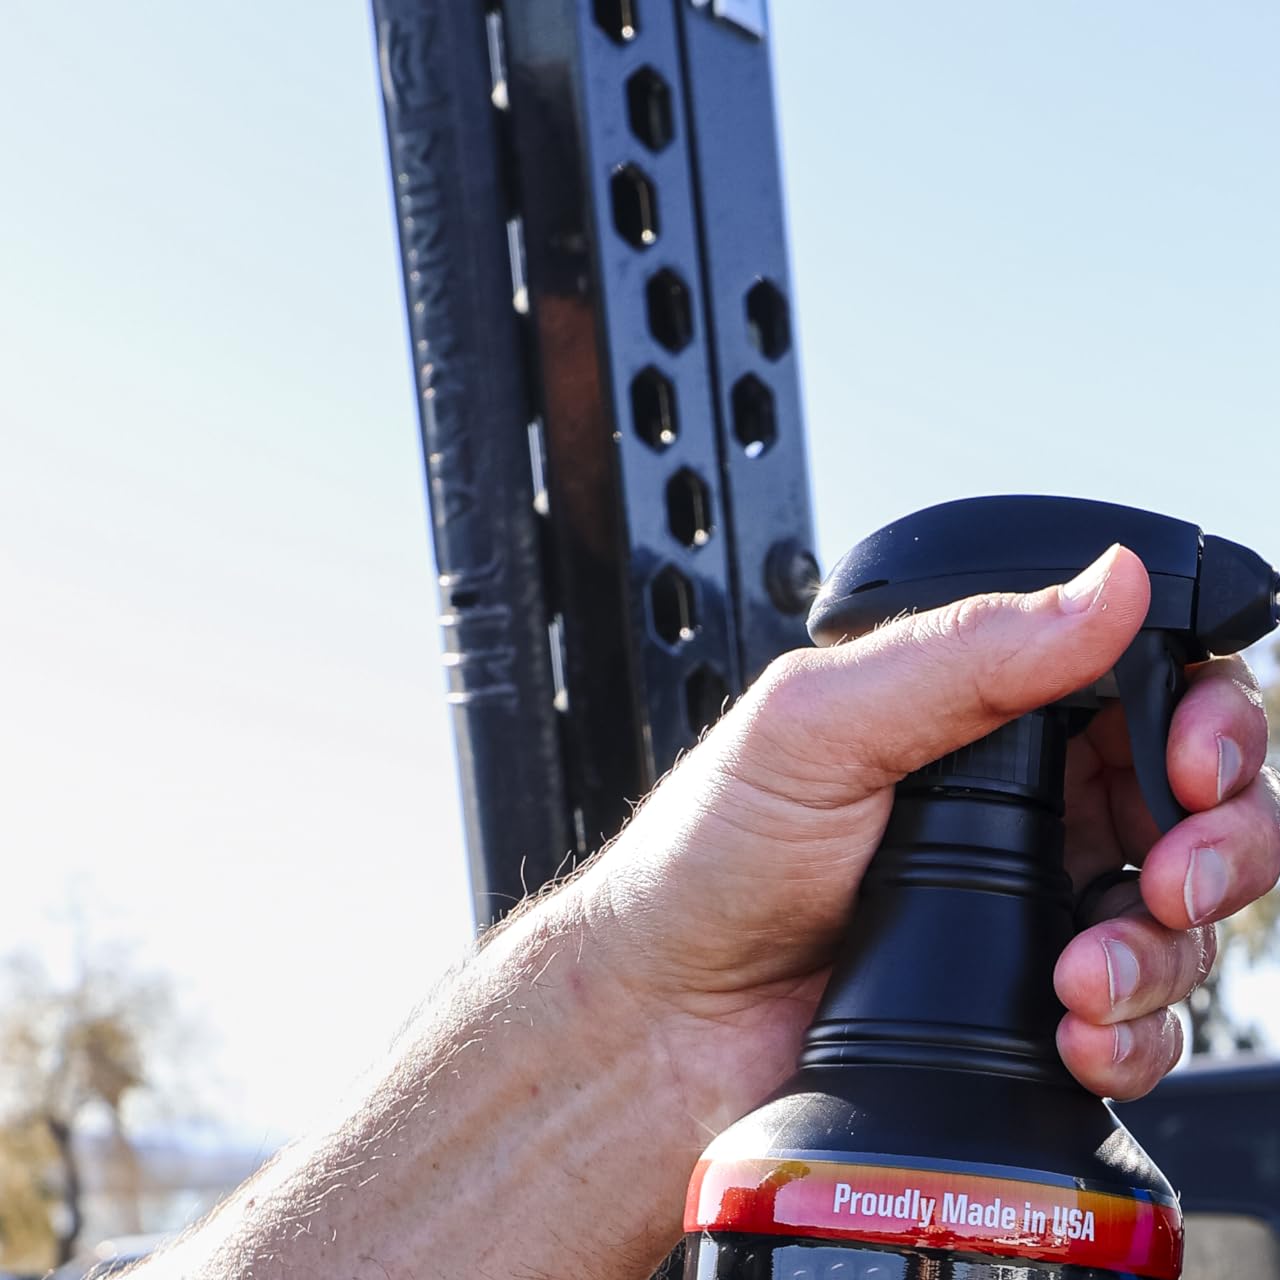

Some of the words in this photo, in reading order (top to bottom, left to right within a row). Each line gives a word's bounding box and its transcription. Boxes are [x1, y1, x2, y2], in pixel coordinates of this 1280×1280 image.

[833, 1183, 937, 1228] Proudly
[941, 1192, 1016, 1230] Made
[1023, 1201, 1046, 1235] in
[1052, 1206, 1095, 1242] USA
